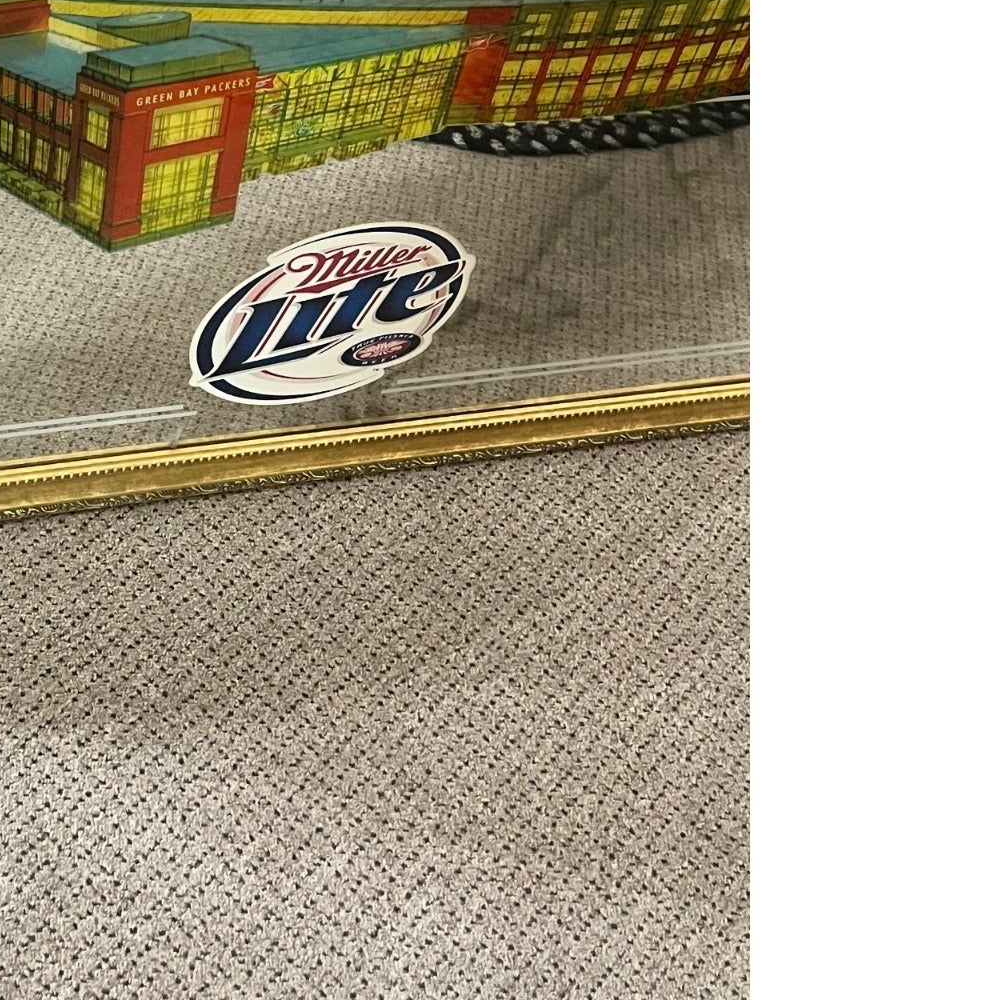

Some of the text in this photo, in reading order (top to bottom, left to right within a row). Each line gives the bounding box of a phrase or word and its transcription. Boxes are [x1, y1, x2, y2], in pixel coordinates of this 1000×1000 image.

[135, 76, 251, 107] GREEN BAY PACKERS
[286, 244, 433, 295] Miller
[203, 260, 467, 379] Lite
